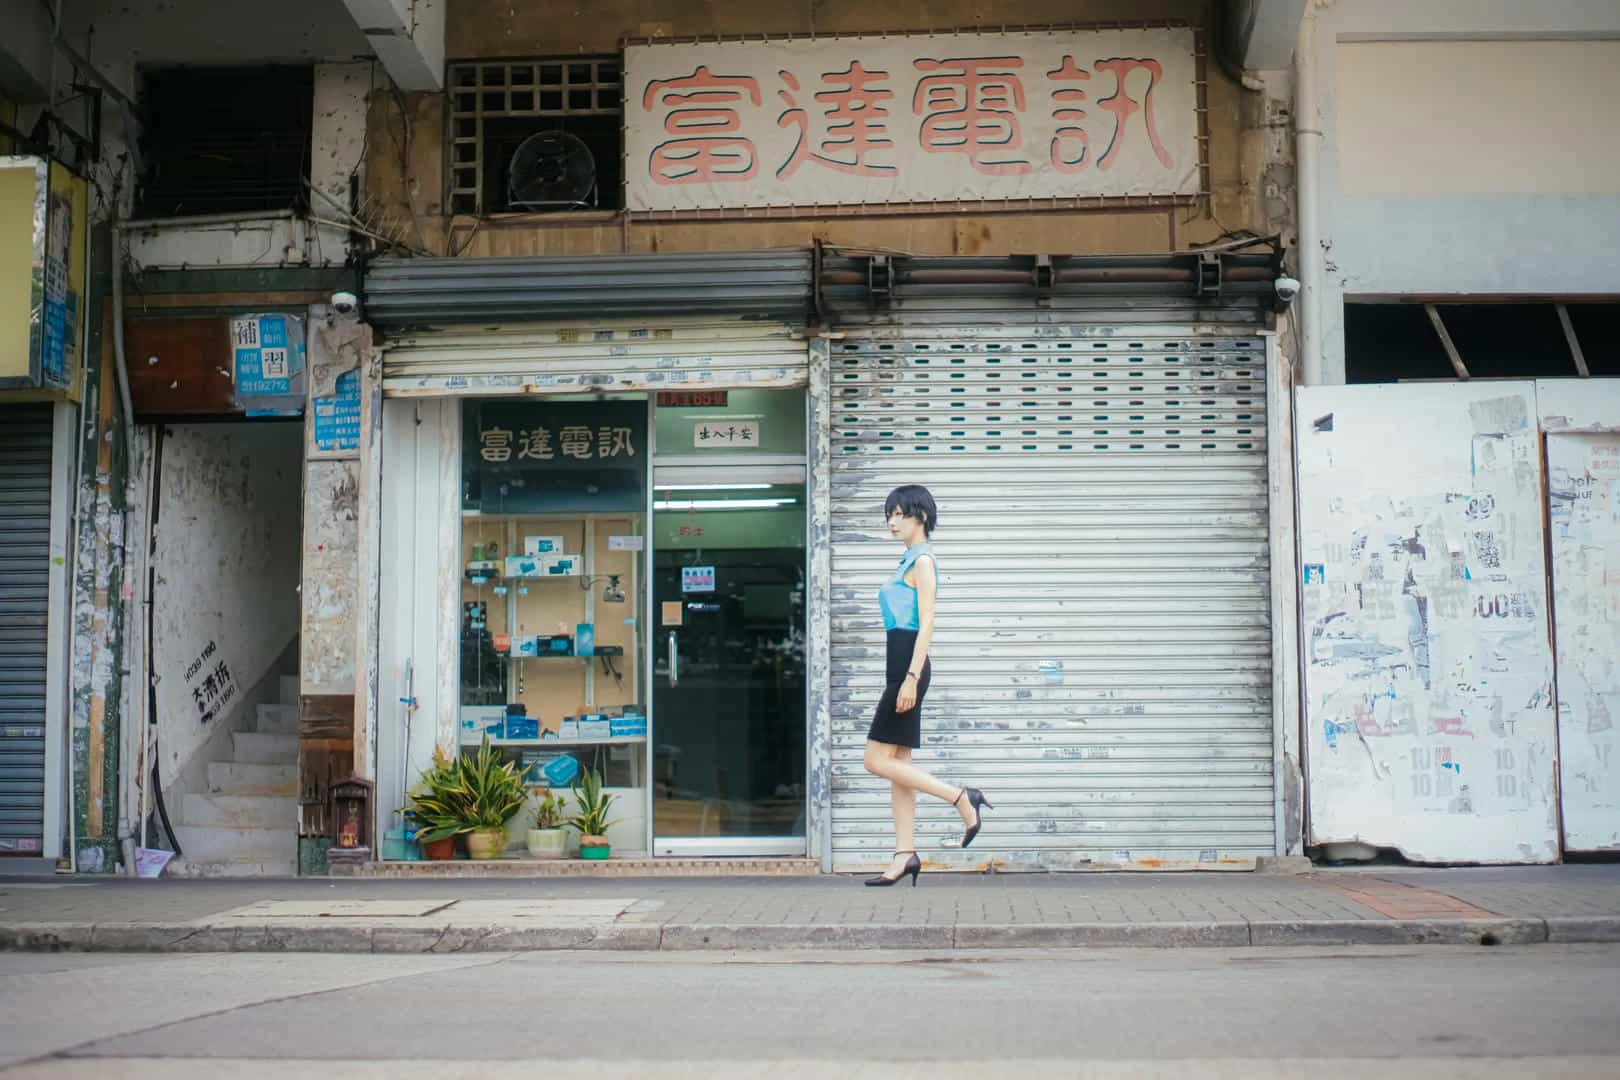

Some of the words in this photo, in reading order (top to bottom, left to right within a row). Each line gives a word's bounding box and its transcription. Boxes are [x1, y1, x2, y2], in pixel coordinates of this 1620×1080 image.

[642, 55, 1175, 184] 富達電訊
[480, 426, 635, 462] 富達電訊
[699, 426, 752, 442] 出入平安
